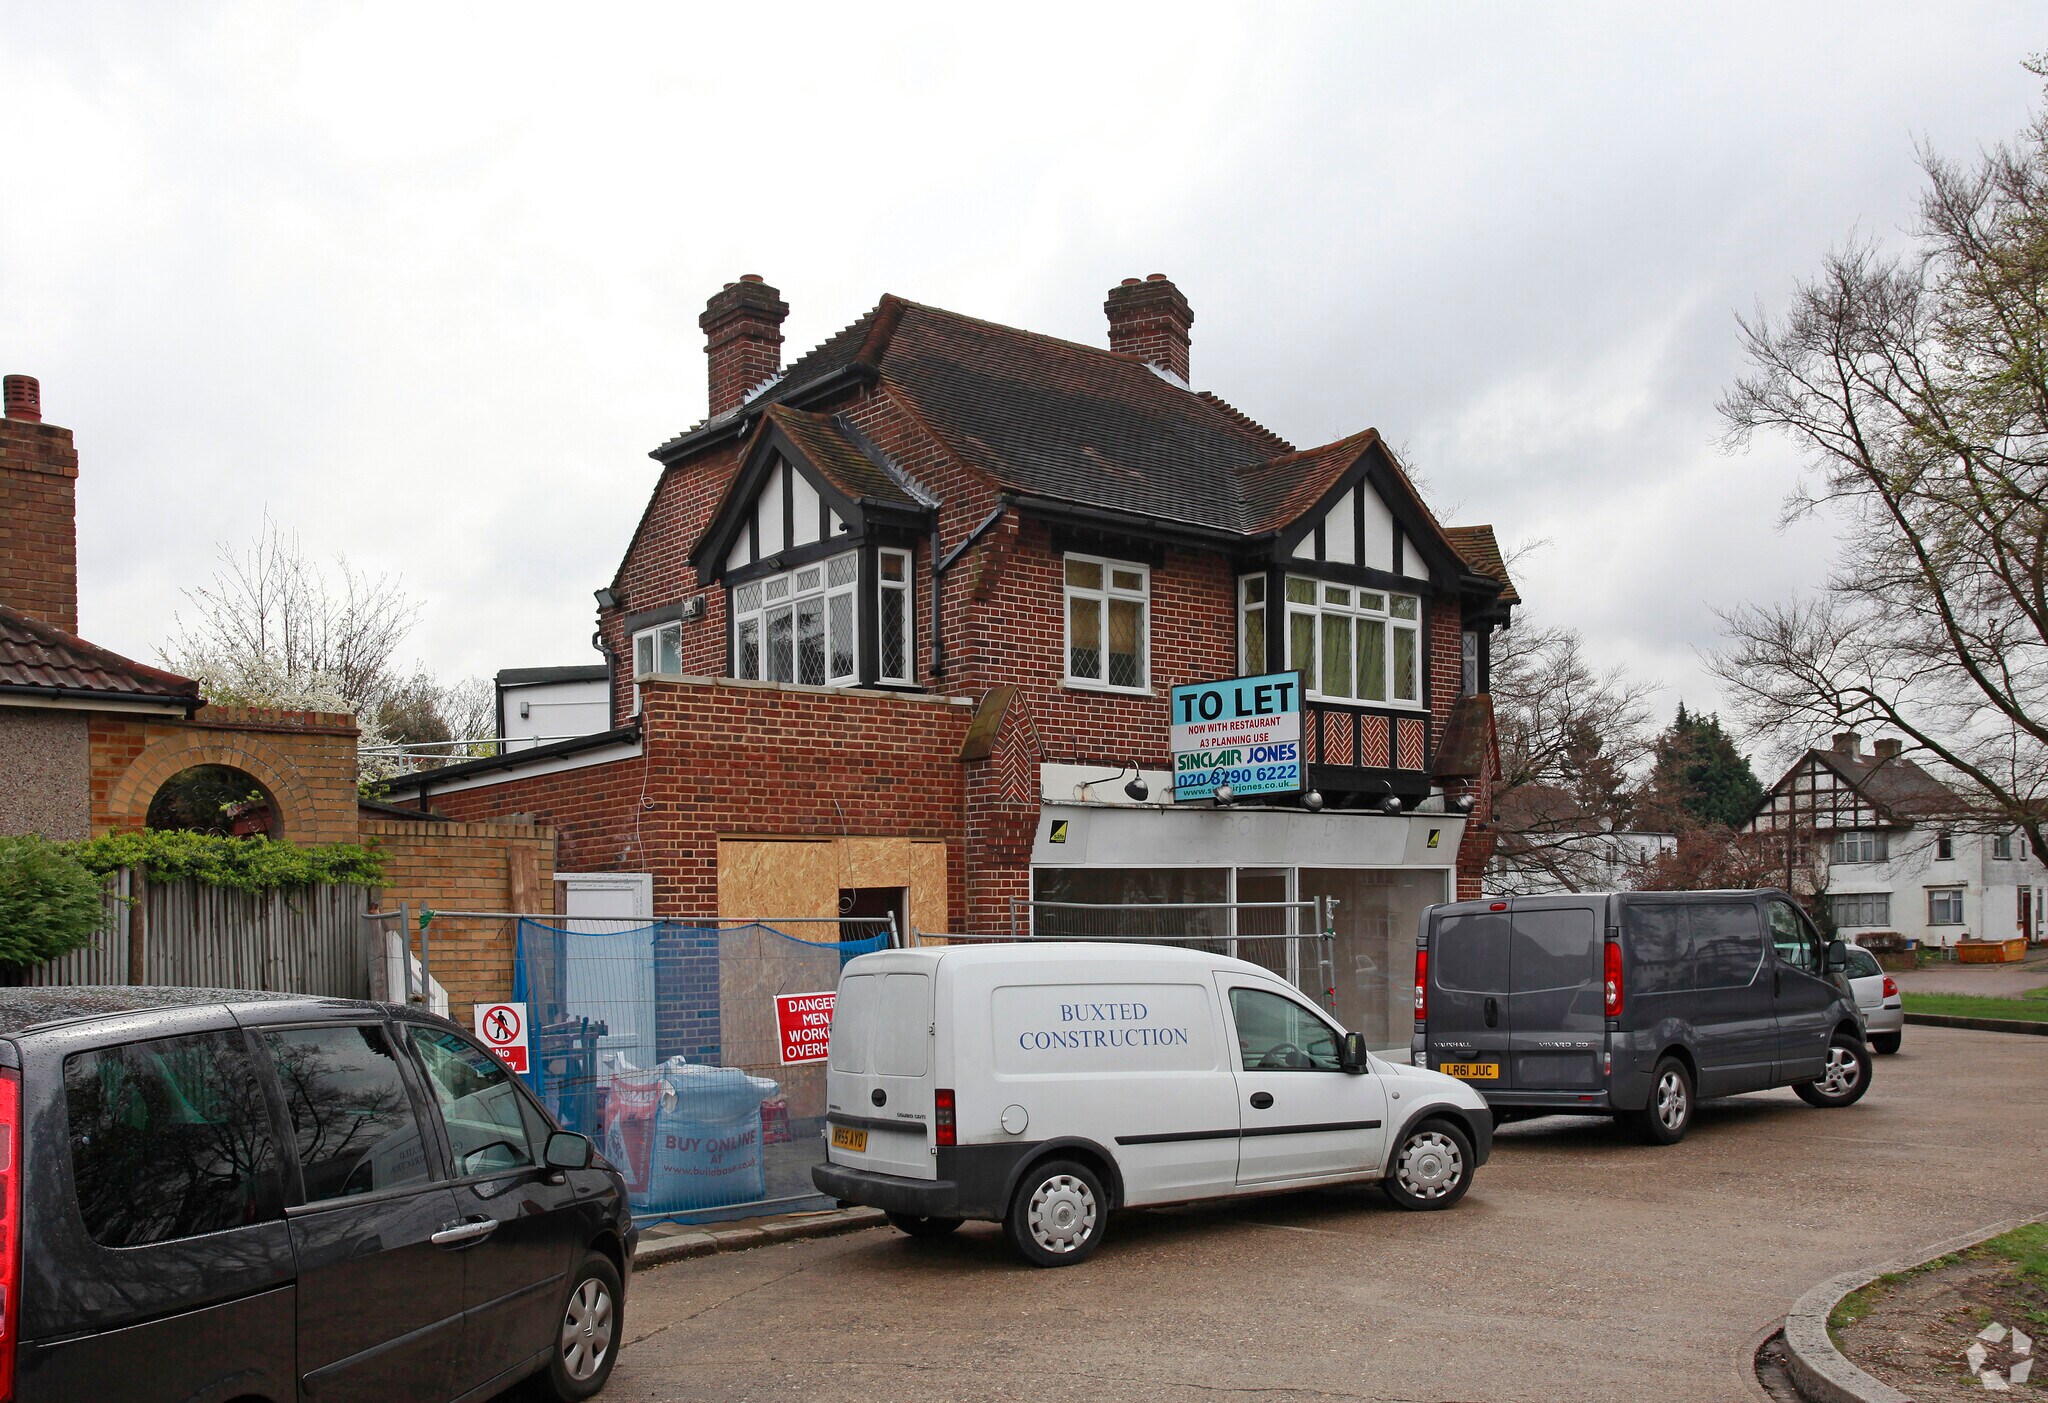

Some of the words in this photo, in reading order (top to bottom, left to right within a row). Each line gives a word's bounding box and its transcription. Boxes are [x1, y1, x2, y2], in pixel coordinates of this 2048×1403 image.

[1179, 690, 1223, 722] TO
[1234, 682, 1294, 717] LET
[1188, 723, 1207, 735] NOW
[1207, 720, 1228, 733] WITH
[1230, 716, 1281, 731] RESTAURANT
[1200, 737, 1210, 748] A3
[1211, 734, 1251, 747] PLANNING
[1253, 732, 1269, 742] USE
[1178, 749, 1242, 771] SINCLAIR
[1247, 743, 1297, 764] JONES
[1178, 773, 1207, 788] 020
[1211, 768, 1251, 786] 8290
[1256, 764, 1297, 782] 6222
[1183, 780, 1289, 797] www.siirjones.co.uk
[803, 1012, 829, 1026] MEN
[1060, 1002, 1148, 1022] BUXTED
[789, 1028, 830, 1043] WORKI
[1019, 1027, 1188, 1050] CONSTRUCTION
[495, 1048, 510, 1058] No
[786, 1042, 829, 1058] OVERH
[1446, 1064, 1470, 1076] LR61
[1472, 1064, 1492, 1076] JUC
[665, 1134, 702, 1153] BUY
[706, 1129, 757, 1154] ONLINE
[710, 1153, 724, 1165] AT
